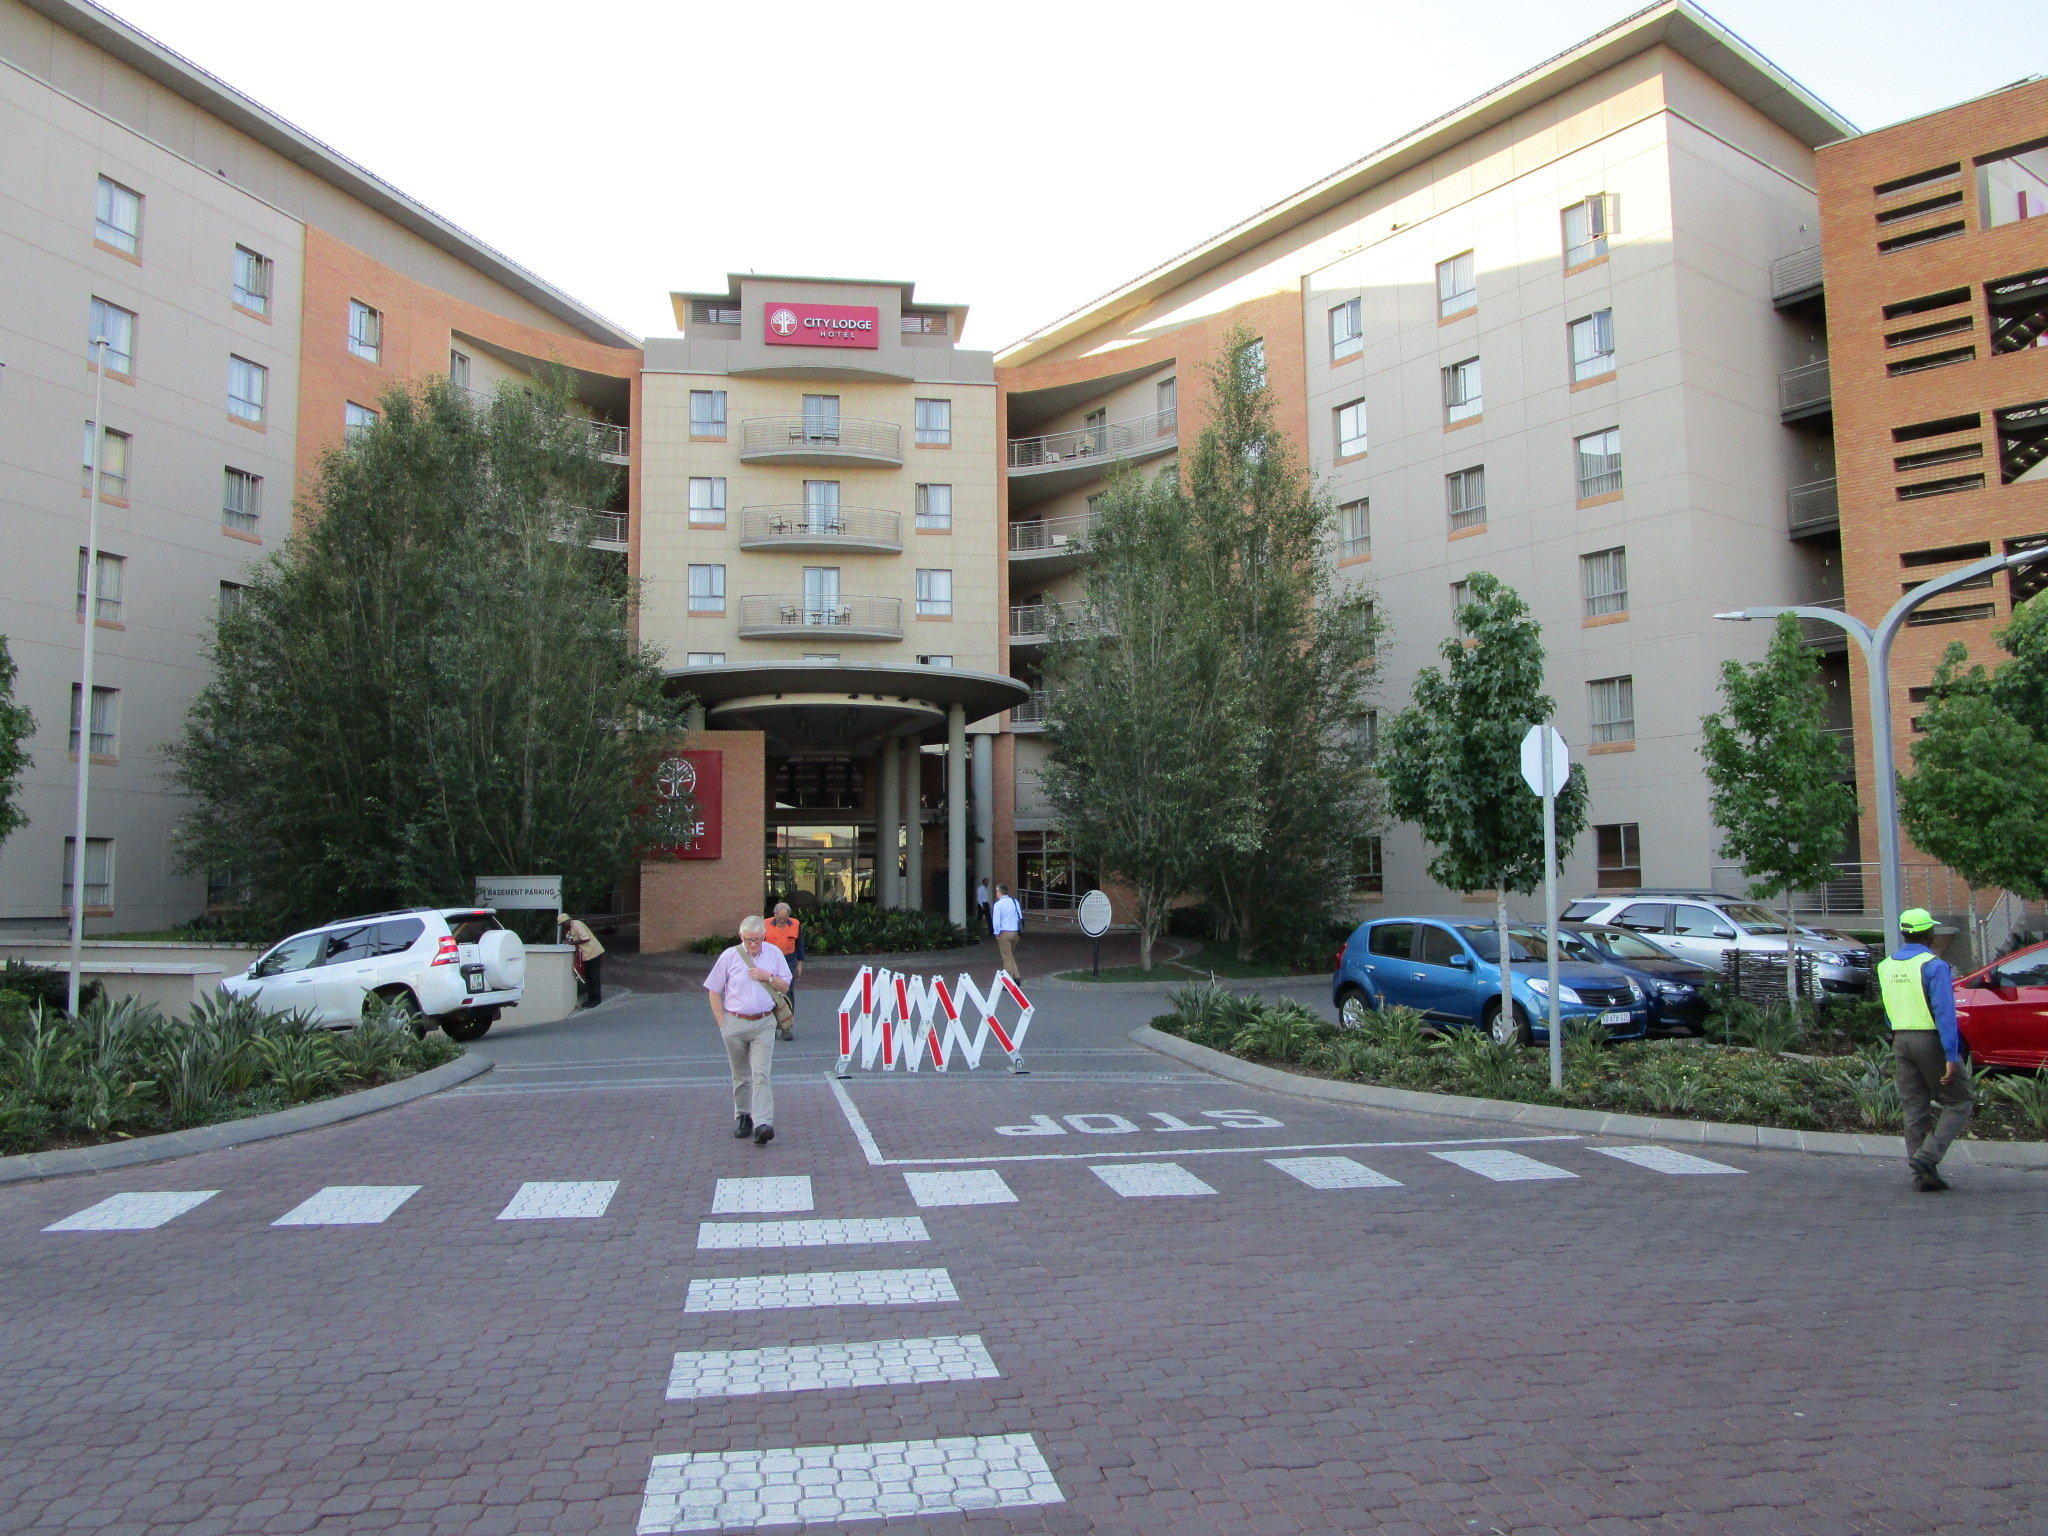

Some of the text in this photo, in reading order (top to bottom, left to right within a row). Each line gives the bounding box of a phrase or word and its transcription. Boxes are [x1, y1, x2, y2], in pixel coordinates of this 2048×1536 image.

[803, 317, 872, 330] CITY LODGE
[820, 331, 856, 339] HOTEL
[488, 888, 555, 896] BASEMENT PARKING
[994, 1108, 1286, 1137] STOP
